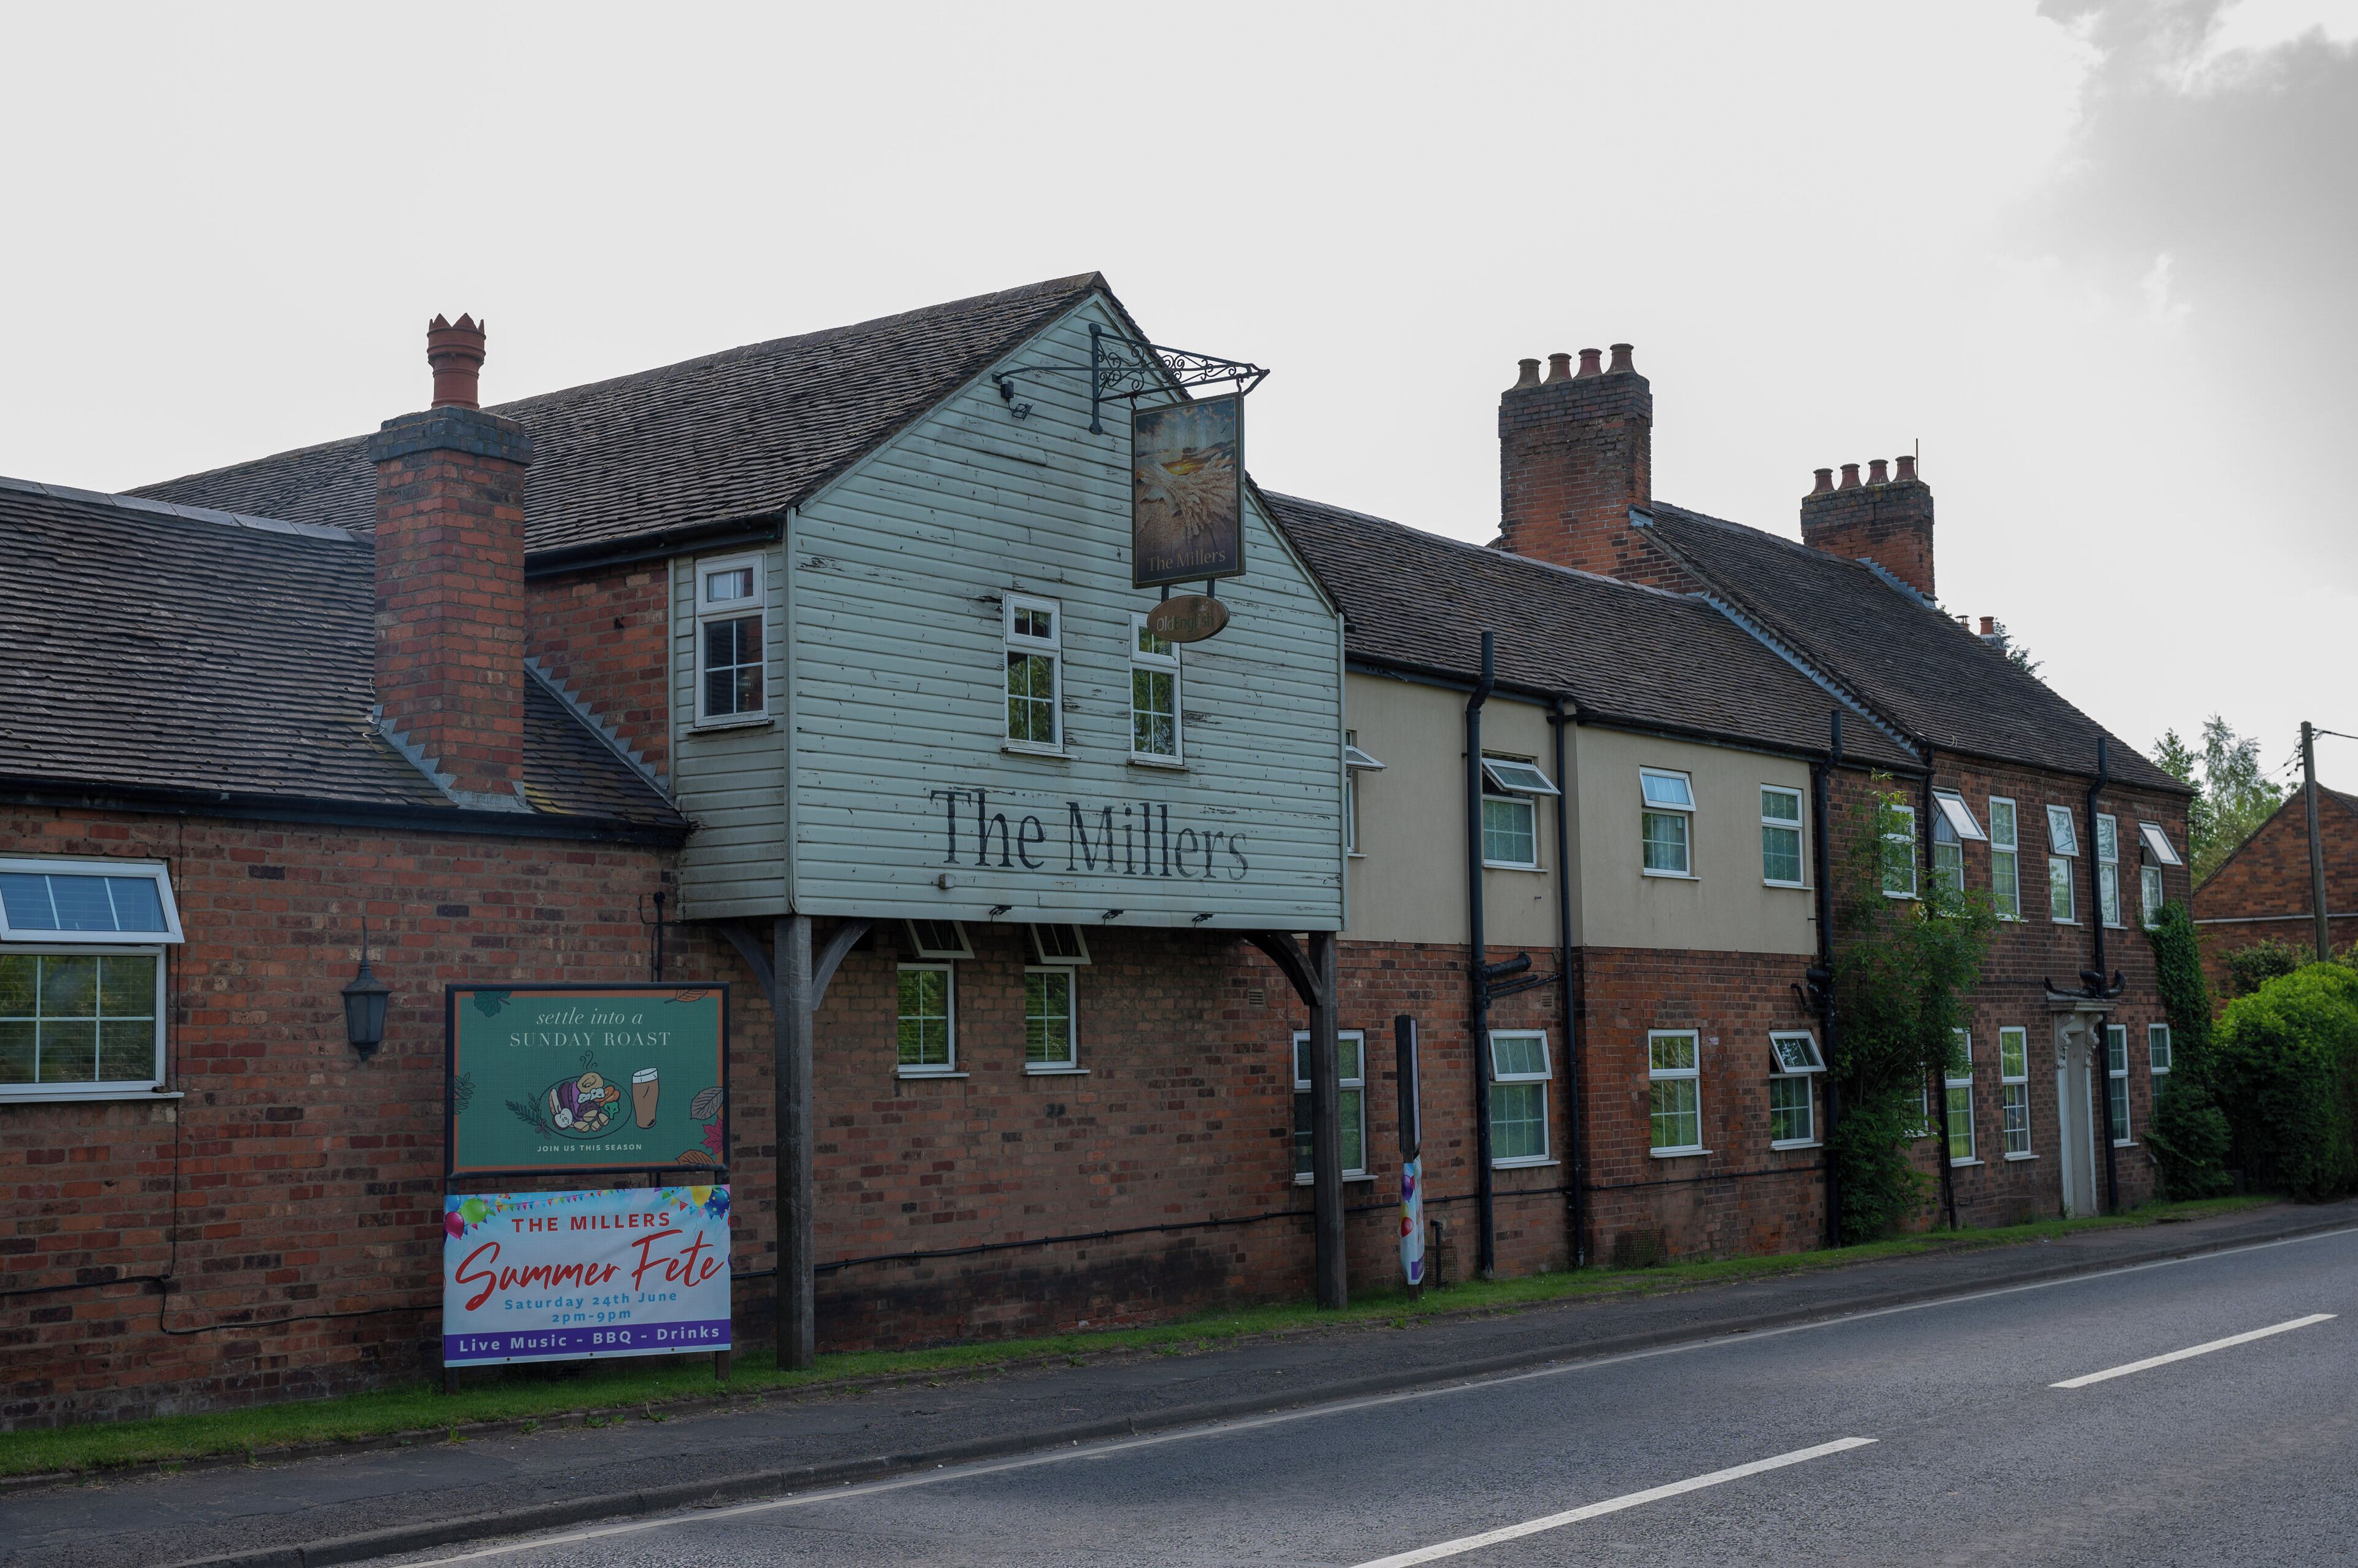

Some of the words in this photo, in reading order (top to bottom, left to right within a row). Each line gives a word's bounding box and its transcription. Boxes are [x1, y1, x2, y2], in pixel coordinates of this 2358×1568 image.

[1147, 556, 1173, 571] The
[1177, 549, 1226, 568] Millers
[930, 788, 1045, 869] The
[1065, 802, 1249, 880] Millers
[536, 1007, 584, 1025] settle
[591, 1008, 625, 1025] into
[631, 1013, 644, 1025] a
[510, 1033, 594, 1047] SUNDAY
[604, 1032, 671, 1046] ROAST
[512, 1217, 558, 1233] THE
[570, 1212, 671, 1230] MILLERS
[455, 1242, 621, 1311] Summer
[631, 1229, 725, 1291] Fete
[504, 1297, 583, 1310] Saturday
[592, 1293, 630, 1306] 24th
[638, 1292, 677, 1303] June
[552, 1310, 631, 1325] 2pm-9pm
[459, 1338, 500, 1352] Live
[510, 1334, 566, 1349] Music
[593, 1330, 631, 1345] BBQ
[656, 1325, 719, 1340] Drinks
